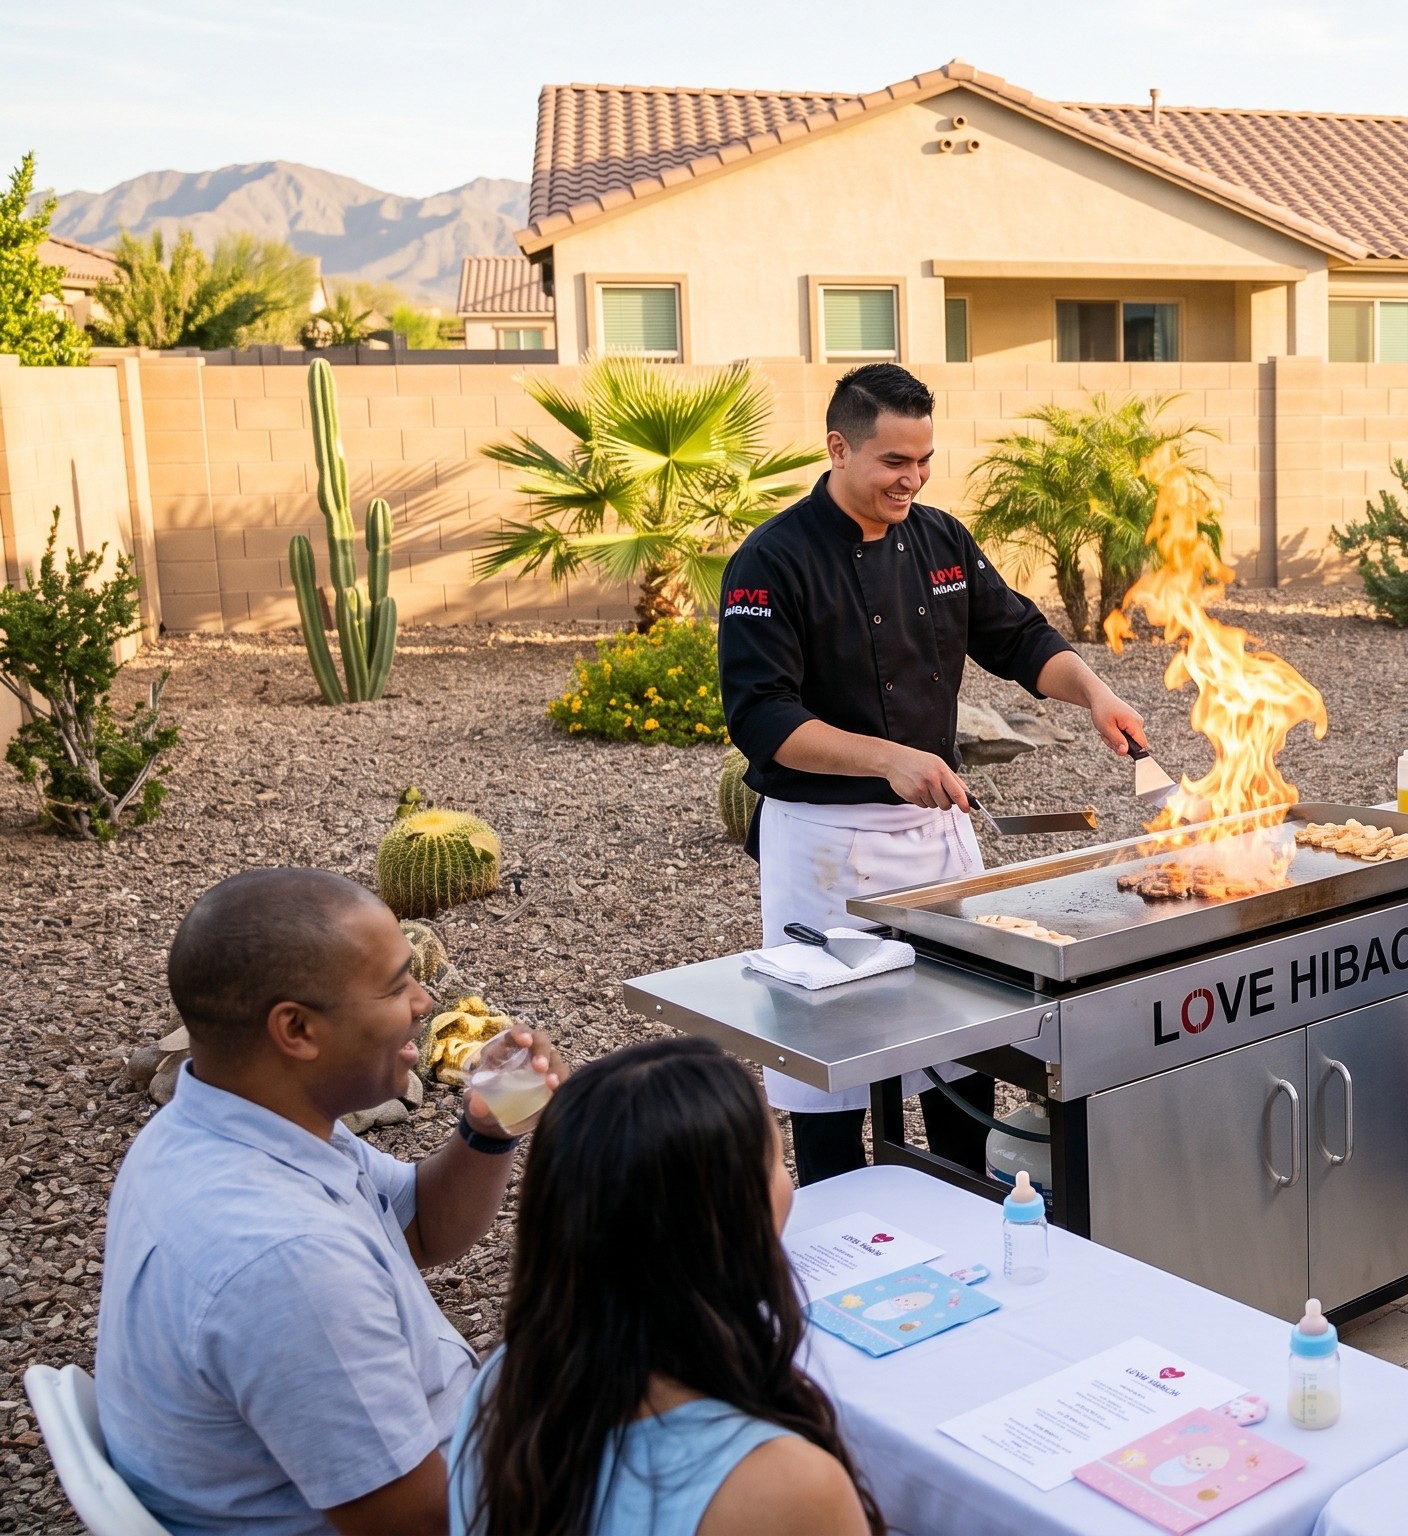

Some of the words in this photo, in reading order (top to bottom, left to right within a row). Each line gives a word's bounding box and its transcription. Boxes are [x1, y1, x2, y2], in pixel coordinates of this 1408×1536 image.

[930, 565, 964, 585] LOVE
[727, 588, 769, 606] LOVE
[1153, 967, 1275, 1047] LOVE
